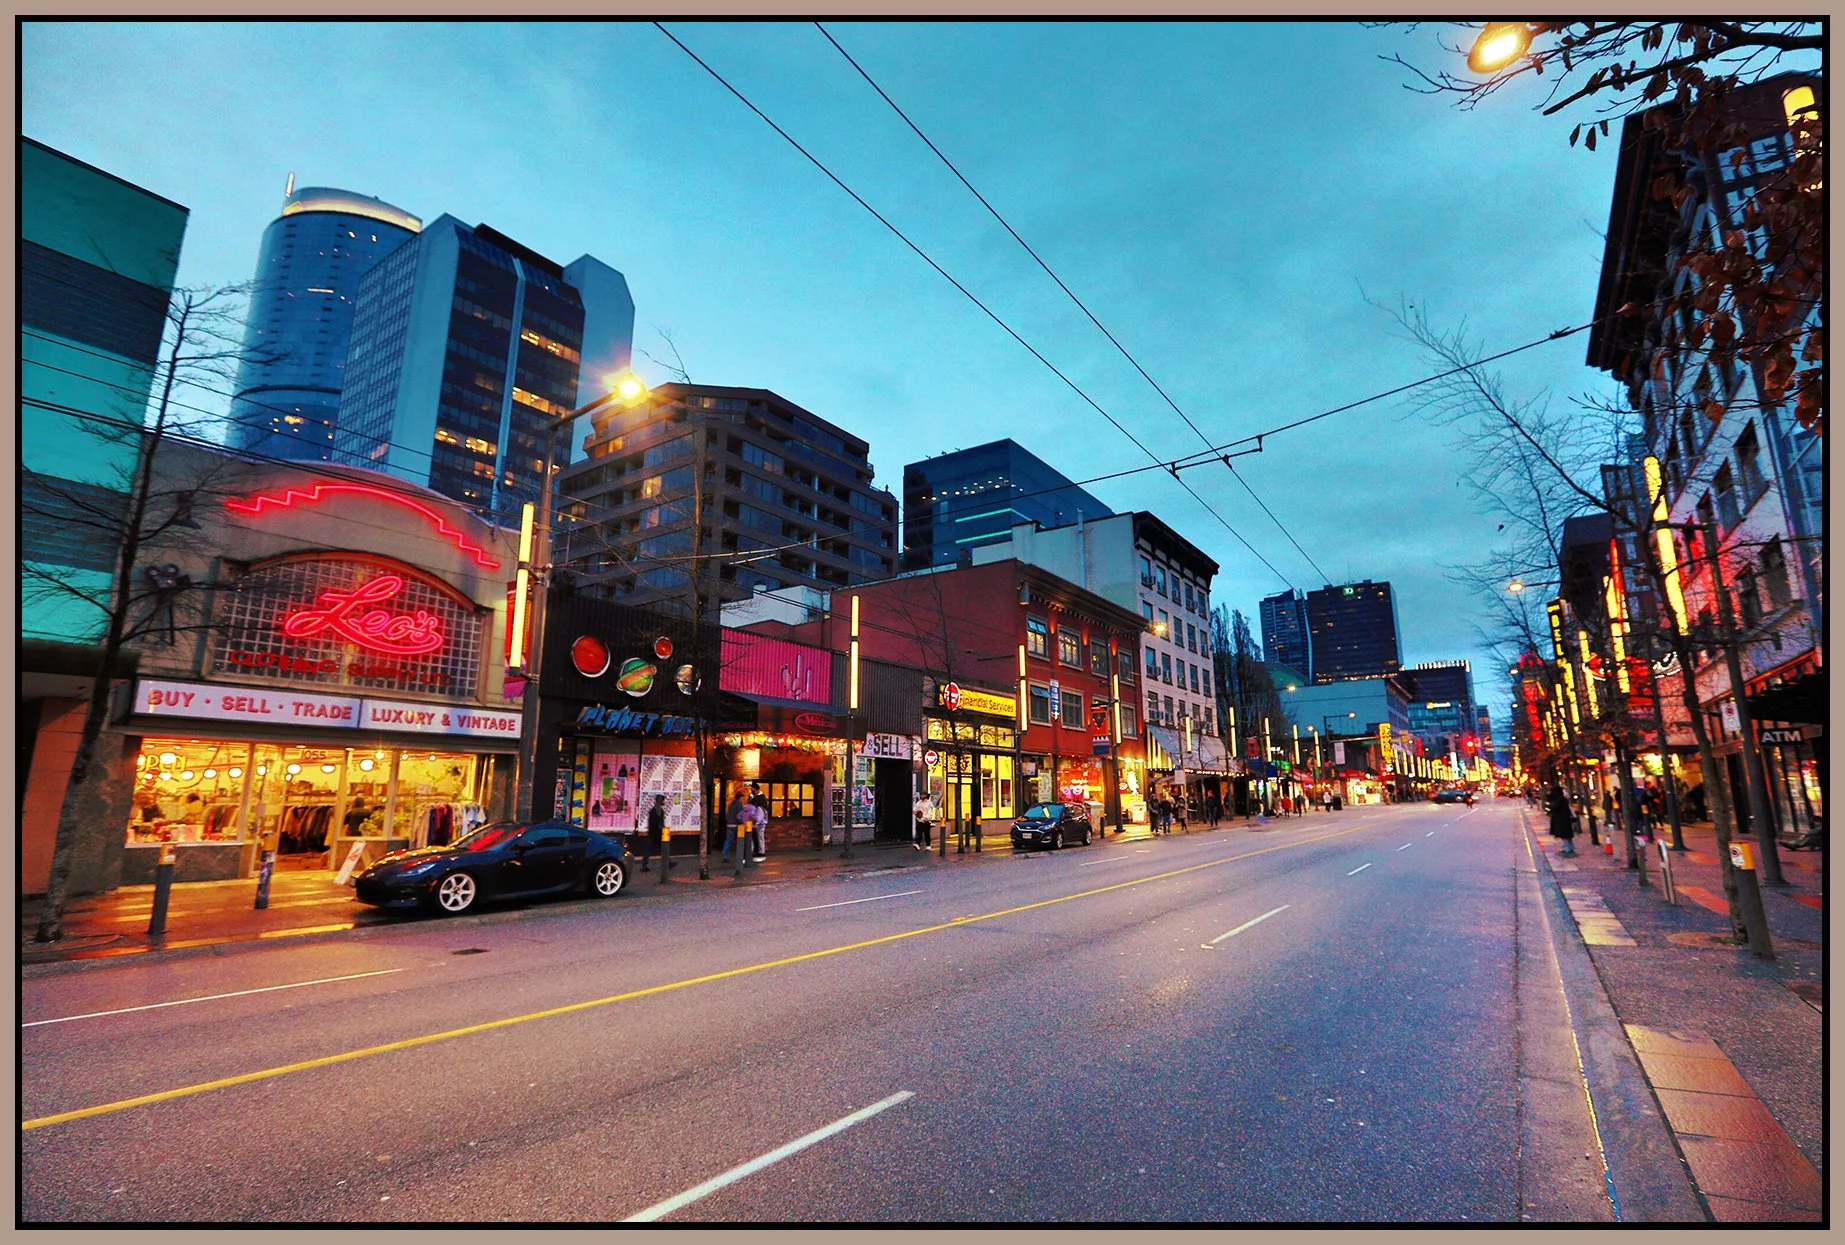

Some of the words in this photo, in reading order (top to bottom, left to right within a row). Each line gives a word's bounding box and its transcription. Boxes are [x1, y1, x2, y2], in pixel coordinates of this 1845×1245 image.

[285, 575, 443, 654] Leo's
[229, 650, 337, 675] CLOTHING
[148, 688, 196, 708] BUY
[222, 695, 271, 714] SELL
[292, 701, 353, 720] TRADE
[371, 708, 435, 726] LUXURY
[441, 713, 451, 726] &
[457, 715, 515, 731] VINTAGE
[578, 704, 659, 733] PLANET
[873, 735, 903, 757] SELL
[1761, 731, 1801, 743] ATM
[302, 750, 326, 760] 1055
